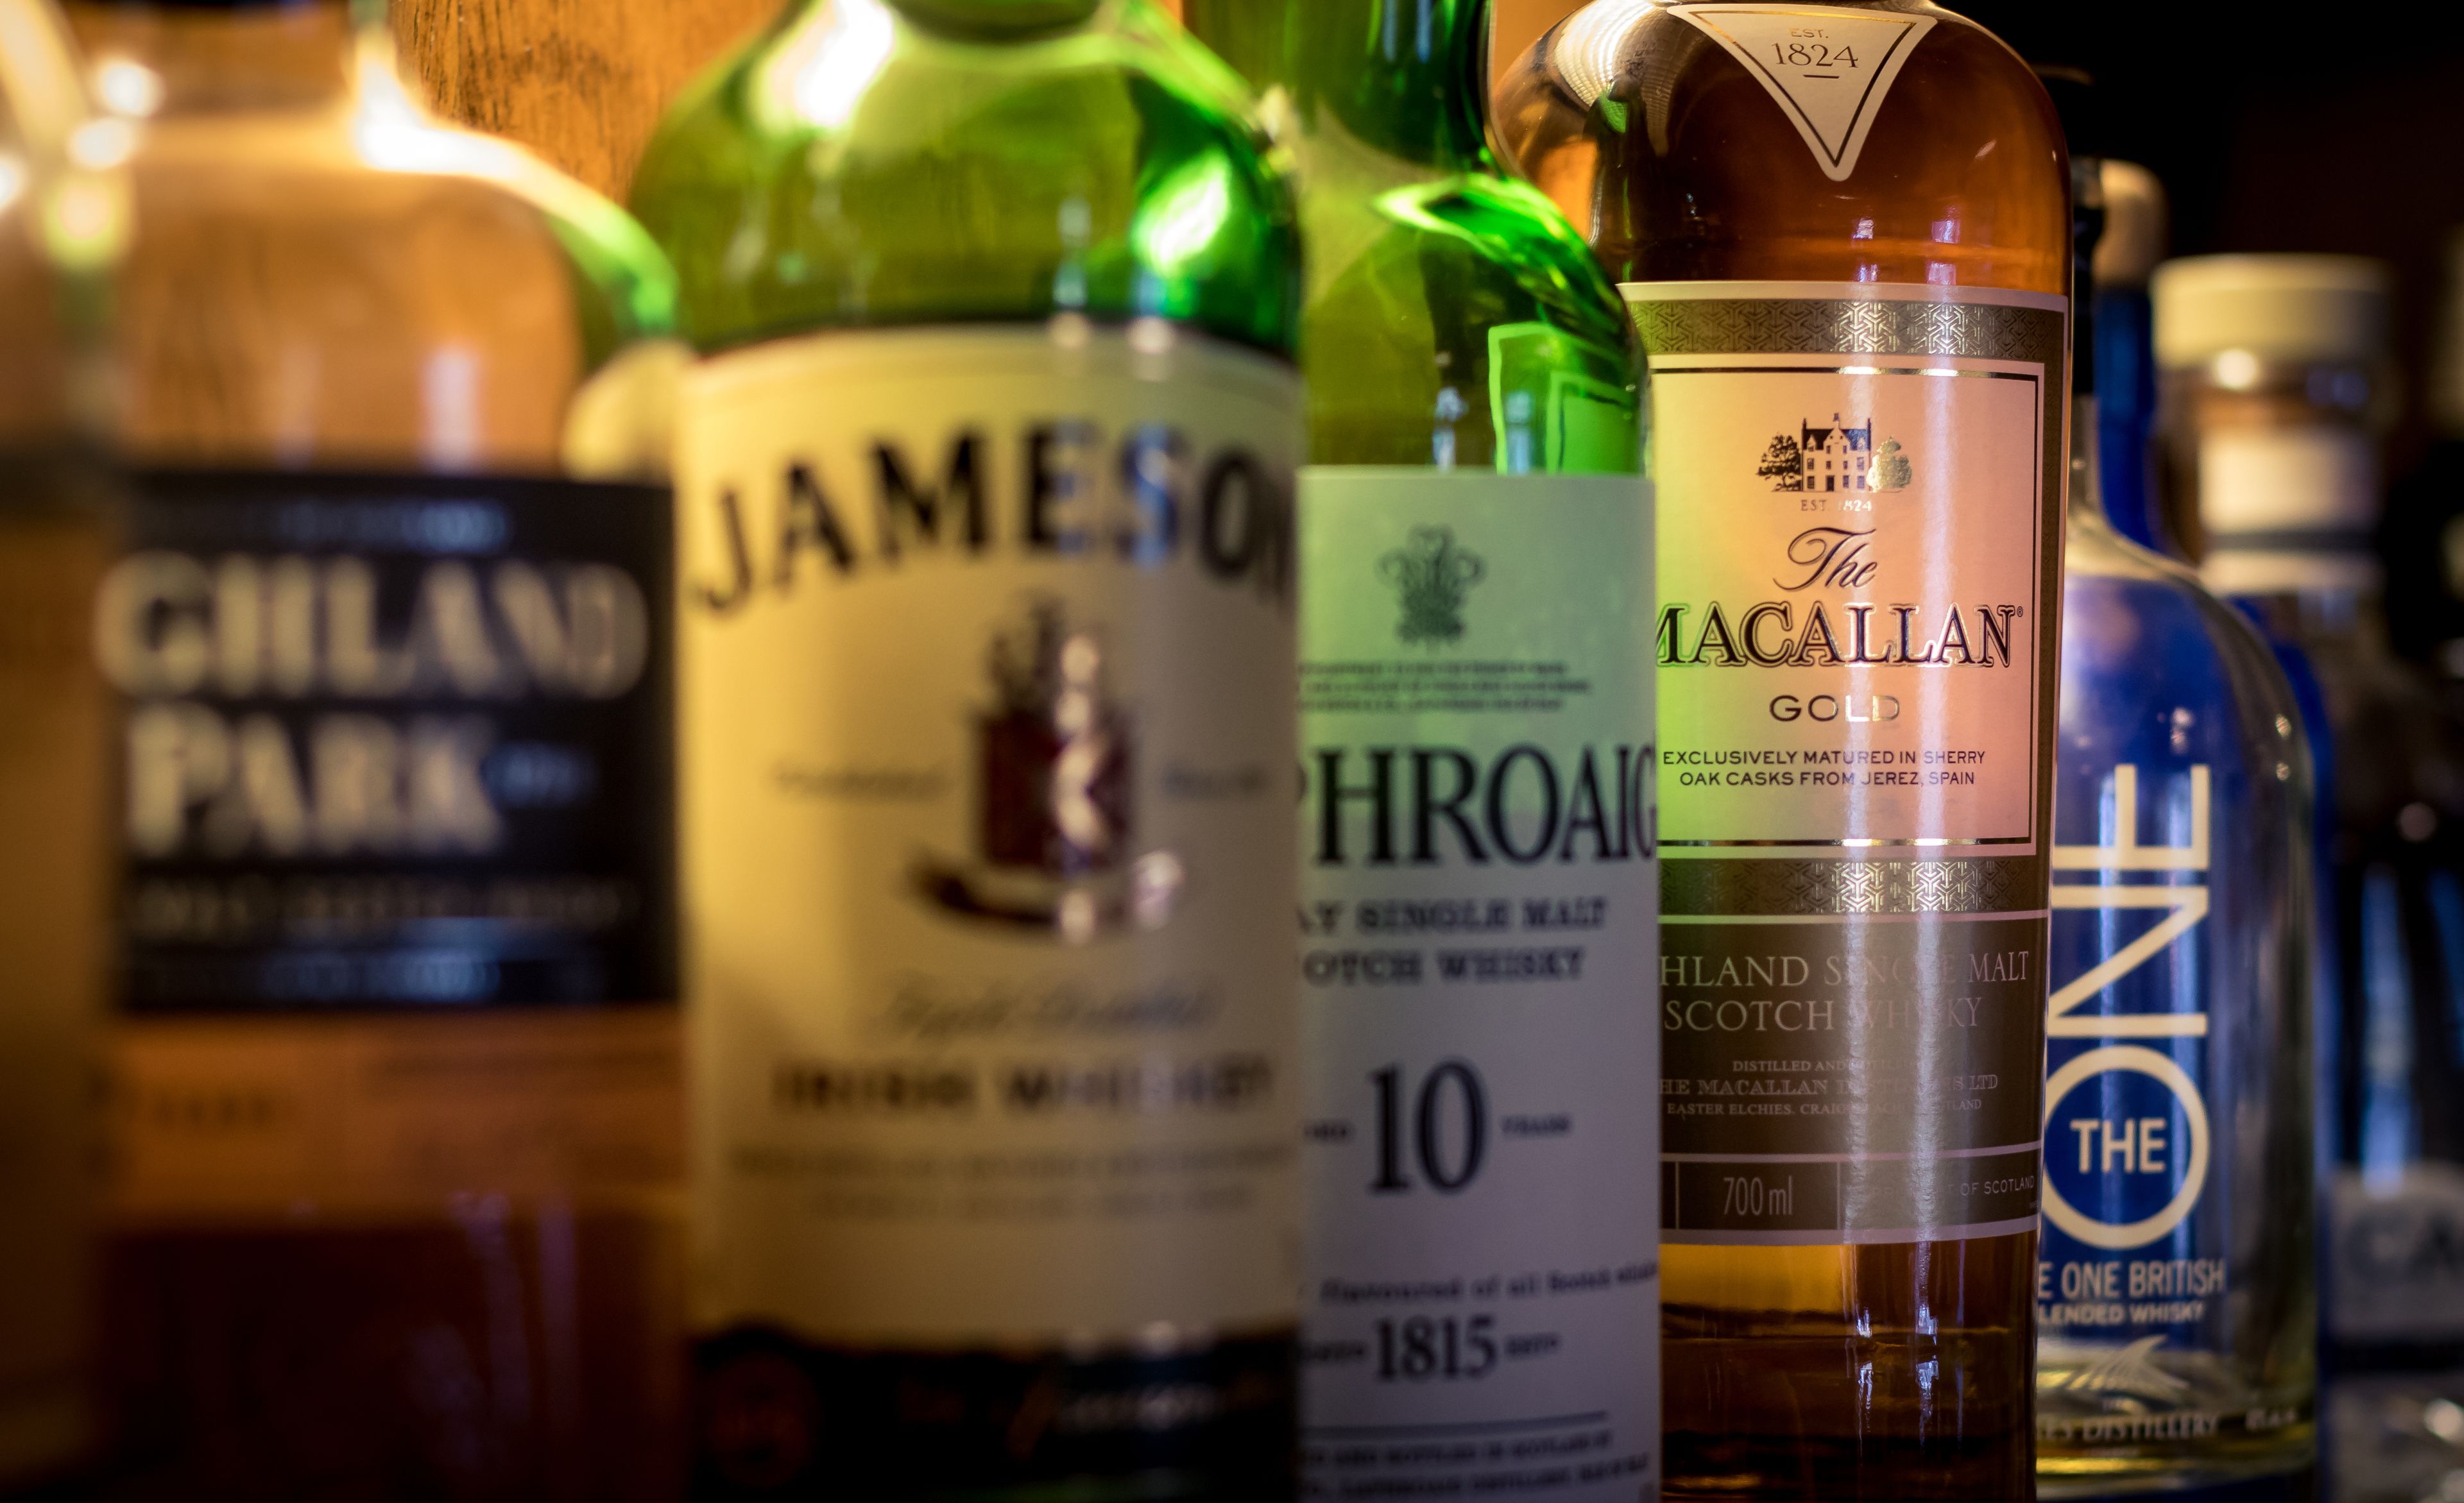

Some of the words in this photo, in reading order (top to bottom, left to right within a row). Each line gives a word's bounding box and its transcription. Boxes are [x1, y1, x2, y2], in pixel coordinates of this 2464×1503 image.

[1790, 28, 1828, 38] EST.
[1772, 42, 1858, 68] 1824
[1838, 499, 1872, 511] 1824
[1773, 526, 1878, 591] The
[1769, 695, 1901, 722] GOLD
[1663, 751, 1797, 765] EXCLUSIVELY
[1803, 751, 1894, 764] MATURED
[1899, 751, 1916, 764] IN
[1924, 751, 1985, 764] SHERRY
[128, 699, 501, 856] PARK
[1680, 772, 1720, 786] OAK
[1726, 772, 1794, 786] CASKS
[1800, 772, 1854, 786] FROM
[1861, 772, 1924, 787] JEREZ,
[1929, 772, 1974, 785] SPAIN
[1967, 950, 2028, 983] MALT
[1663, 1000, 1834, 1032] SCOTCH
[1733, 1060, 1810, 1072] DISTILLED
[1697, 1079, 1828, 1095] MACALLAN
[1969, 1074, 1998, 1091] LTD
[1668, 1103, 1724, 1115] EASTER
[1367, 1057, 1490, 1193] 10
[2071, 1118, 2167, 1173] THE
[1723, 1176, 1763, 1216] 700
[1768, 1175, 1793, 1215] ml
[1960, 1183, 1979, 1196] OF
[1983, 1175, 2034, 1194] SCOTLAND
[2061, 1262, 2121, 1299] ONE
[2129, 1258, 2225, 1298] BRITISH
[2130, 1302, 2205, 1323] WHISKY
[1375, 1314, 1499, 1382] 1815
